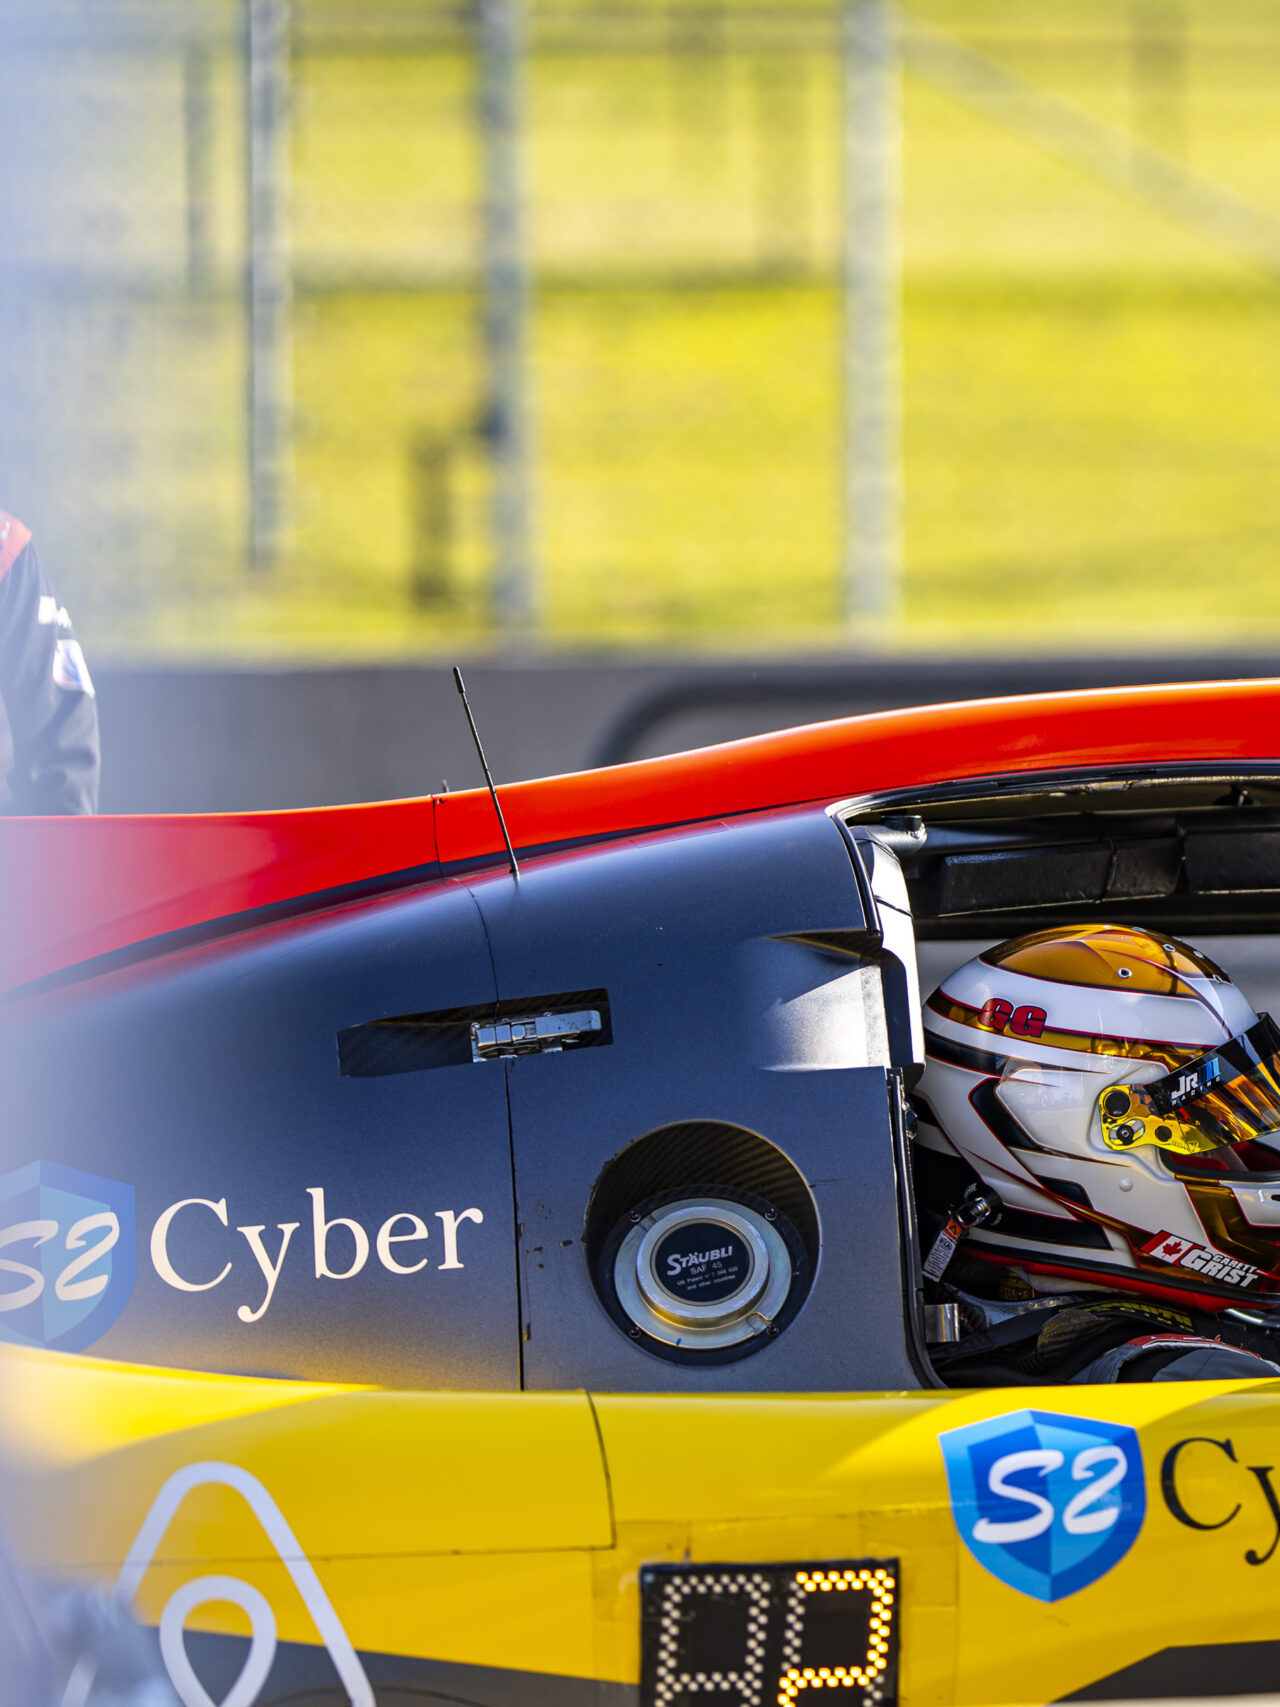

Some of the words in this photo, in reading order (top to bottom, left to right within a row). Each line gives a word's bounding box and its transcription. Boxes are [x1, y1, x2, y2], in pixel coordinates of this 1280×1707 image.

[978, 997, 1048, 1038] GG
[150, 1187, 484, 1323] Cyber
[1180, 1248, 1259, 1288] GRIST
[972, 1445, 1128, 1543] S2
